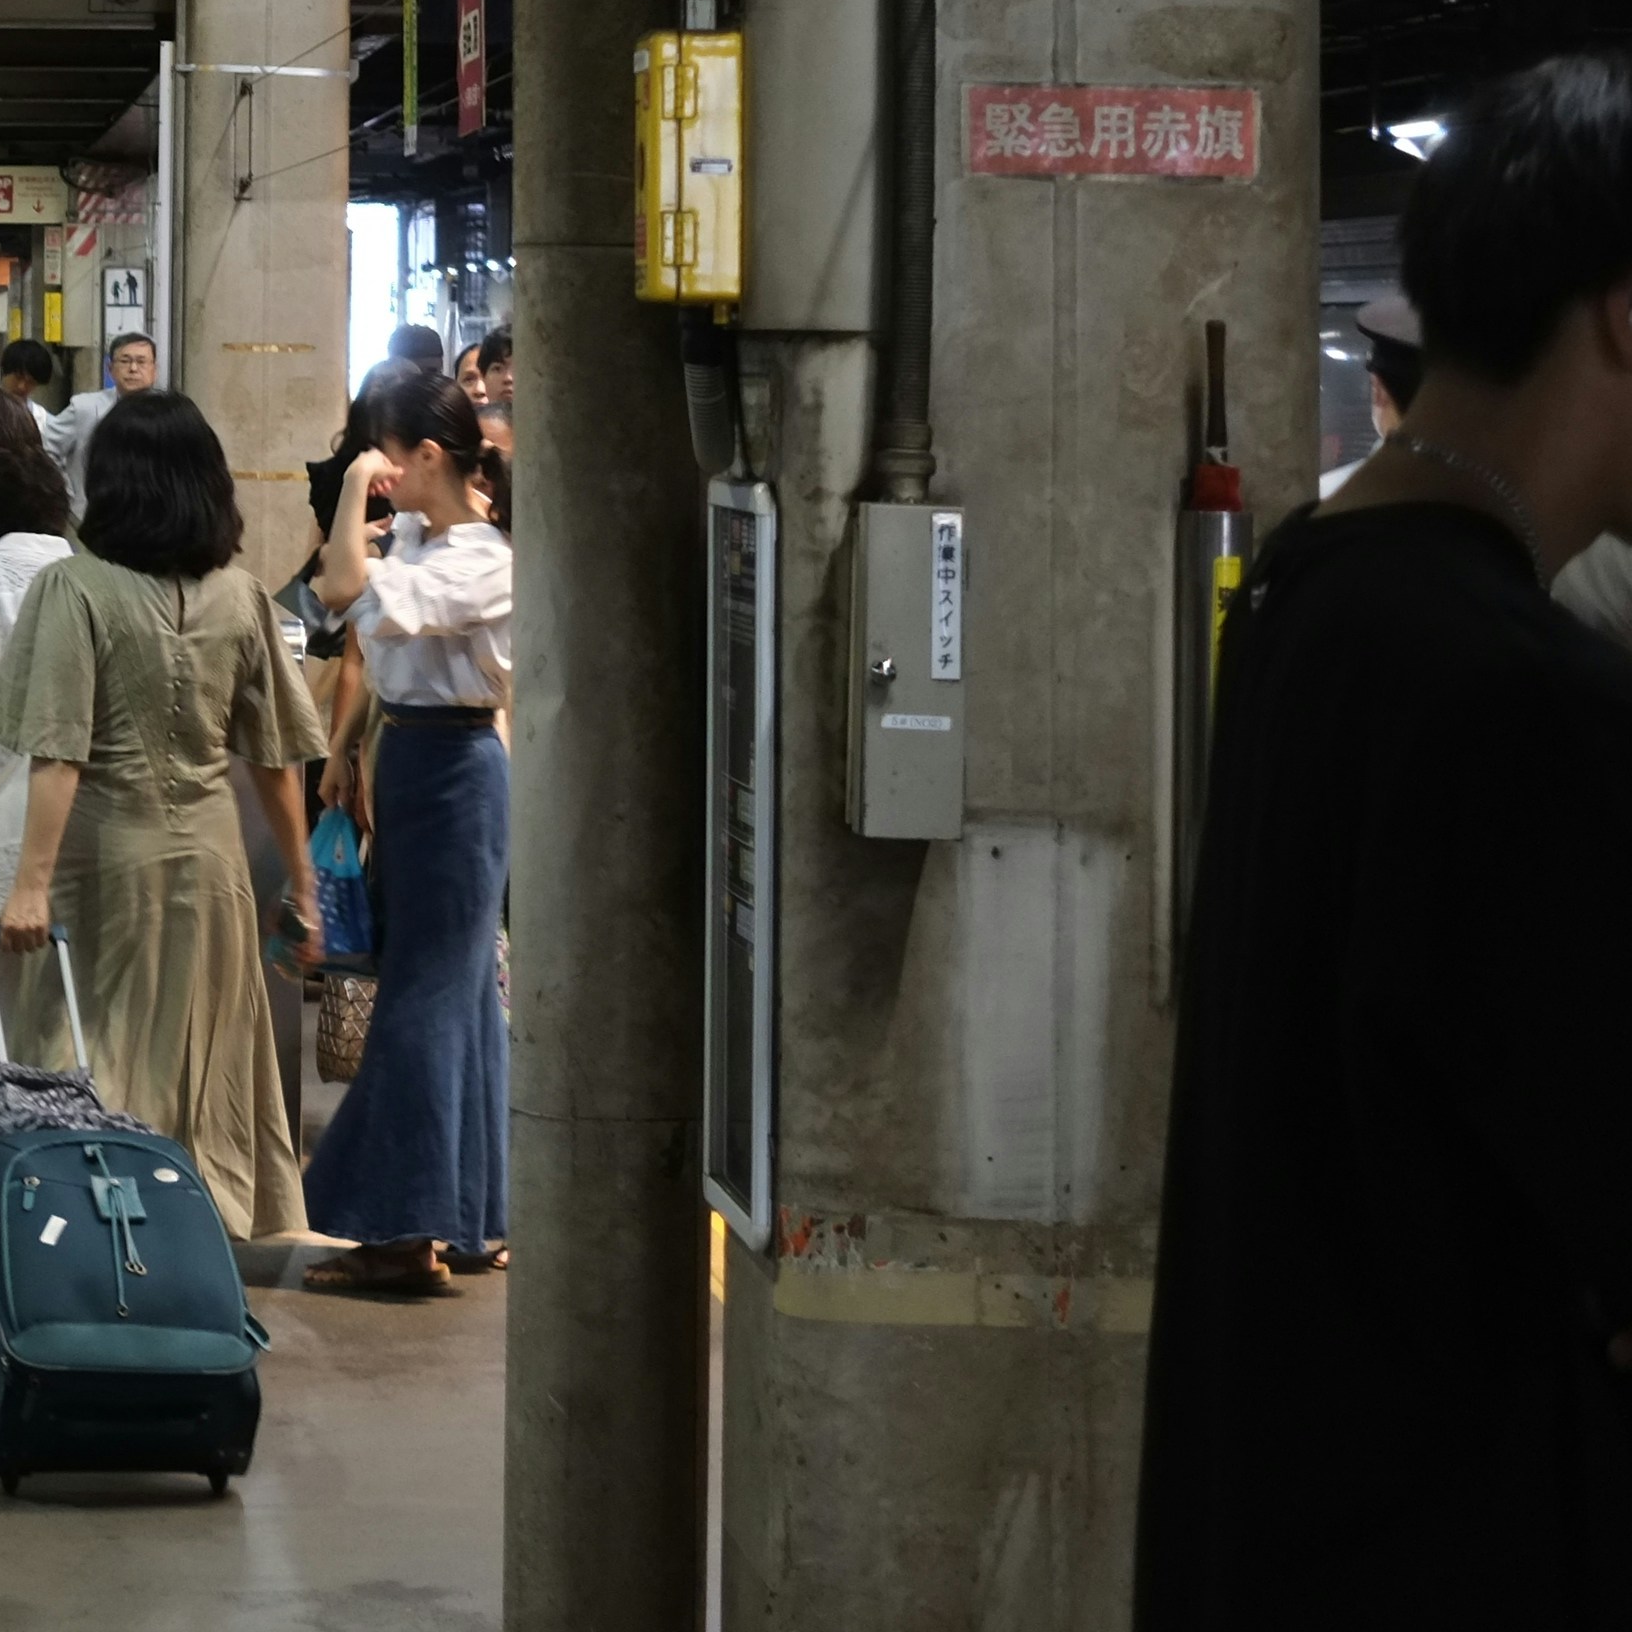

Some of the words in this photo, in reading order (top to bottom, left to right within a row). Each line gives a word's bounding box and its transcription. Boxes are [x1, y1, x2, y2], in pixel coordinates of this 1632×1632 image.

[984, 103, 1246, 163] 緊急用赤旗
[935, 522, 957, 671] 作業中スイッチ
